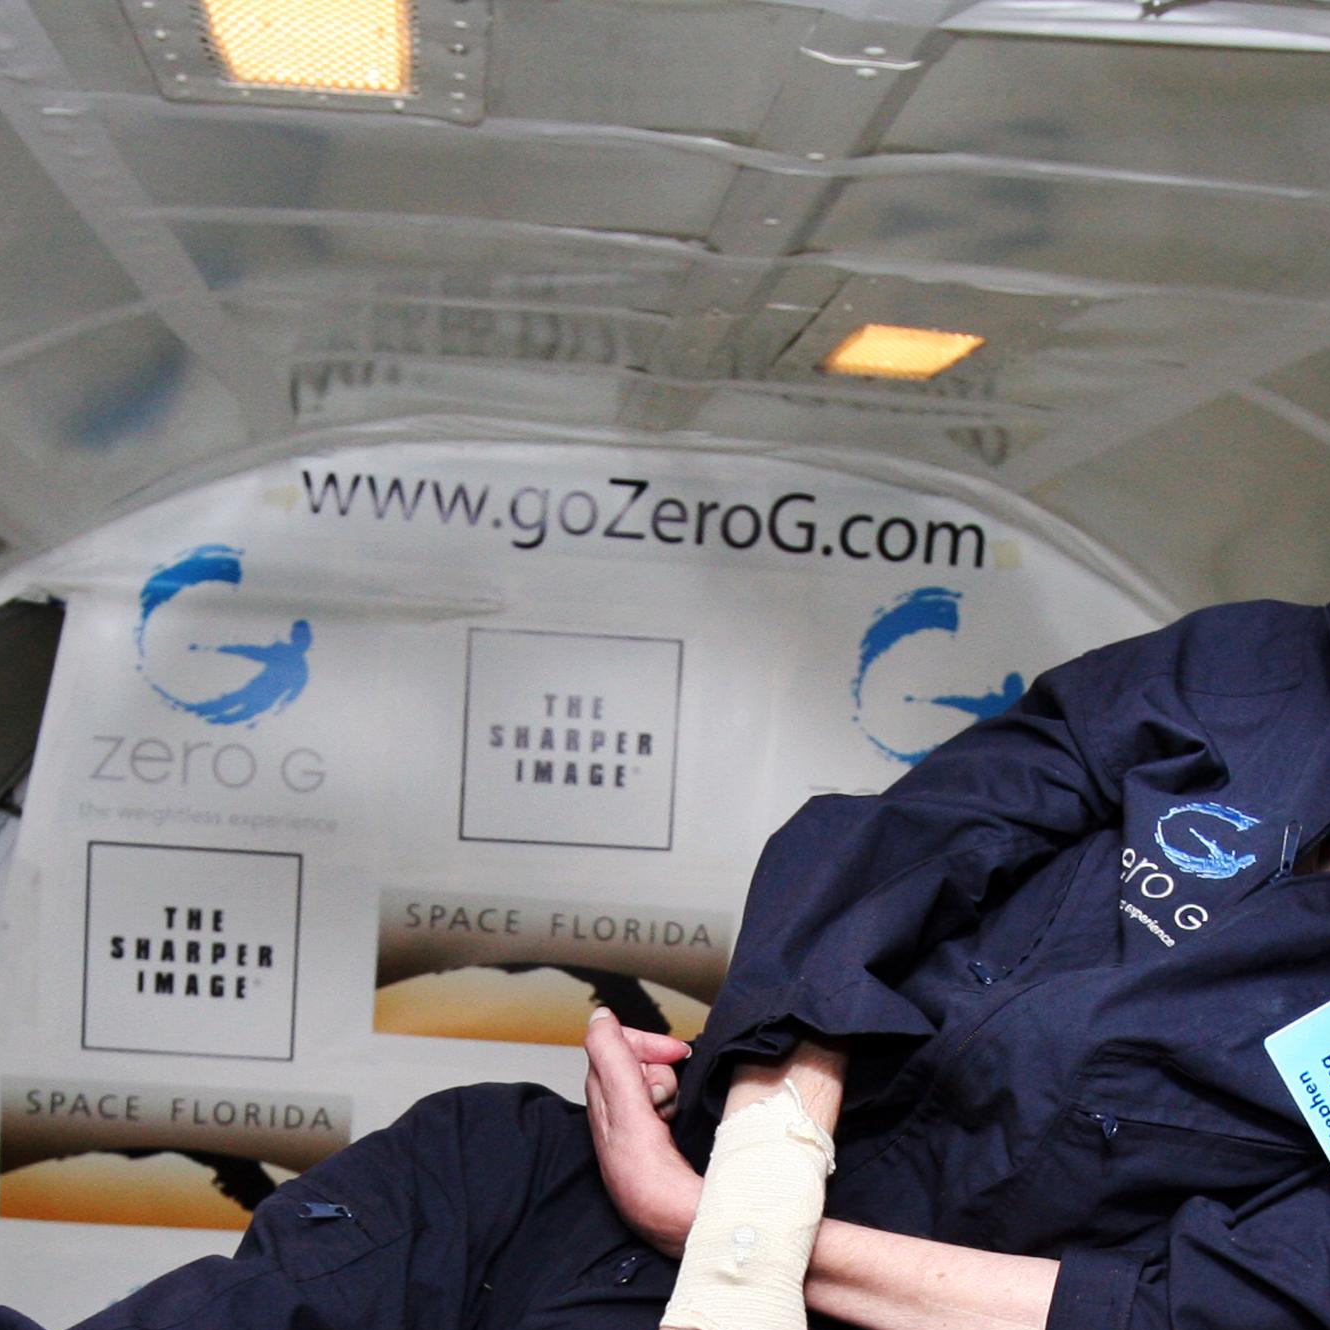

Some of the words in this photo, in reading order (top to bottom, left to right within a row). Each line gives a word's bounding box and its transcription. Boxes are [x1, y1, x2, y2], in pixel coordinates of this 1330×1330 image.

[302, 470, 985, 568] www.goZeroG.com
[544, 693, 604, 721] THE
[489, 724, 653, 756] SHARPER
[89, 734, 258, 790] zero
[281, 747, 327, 794] G
[1121, 847, 1175, 899] ero
[1174, 903, 1209, 931] G
[164, 906, 224, 933] THE
[405, 902, 522, 935] SPACE
[549, 912, 713, 948] FLORIDA
[110, 935, 273, 968] SHARPER
[136, 970, 246, 999] IMAGE
[25, 1089, 142, 1121] SPACE
[169, 1097, 334, 1131] FLORIDA
